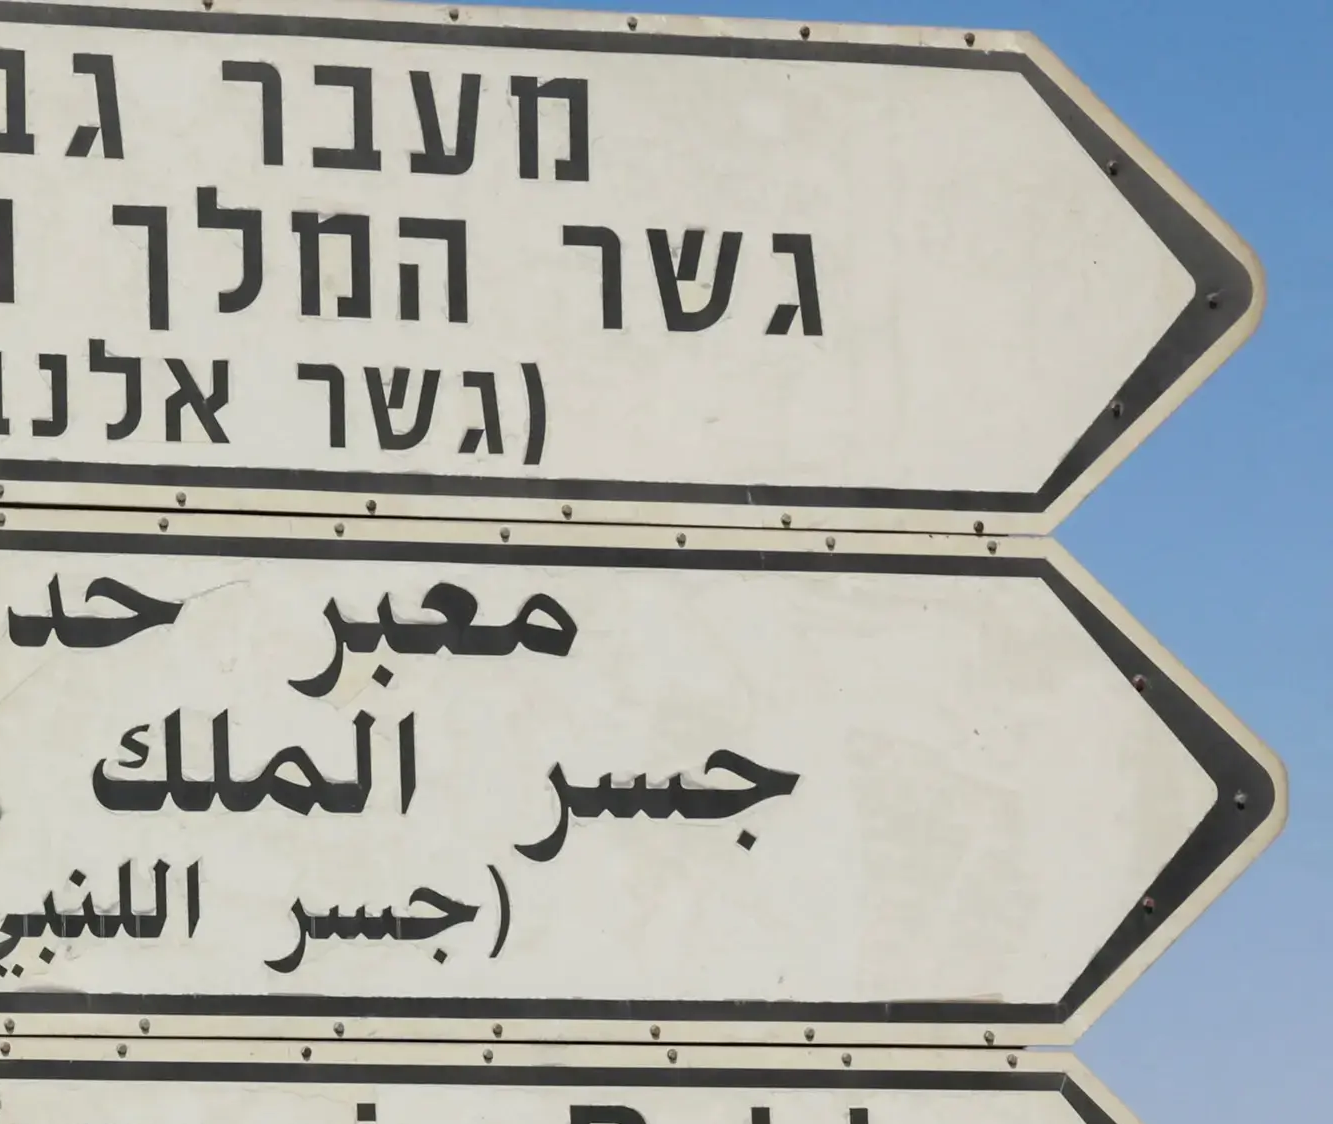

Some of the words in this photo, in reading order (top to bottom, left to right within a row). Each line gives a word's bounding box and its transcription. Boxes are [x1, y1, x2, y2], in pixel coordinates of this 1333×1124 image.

[222, 61, 590, 181] מעבר
[113, 187, 468, 330] המלך
[563, 226, 823, 335] גשר
[298, 363, 546, 464] (גשר
[288, 580, 577, 697] معبر
[93, 709, 415, 815] الملك
[514, 745, 800, 862] جسر
